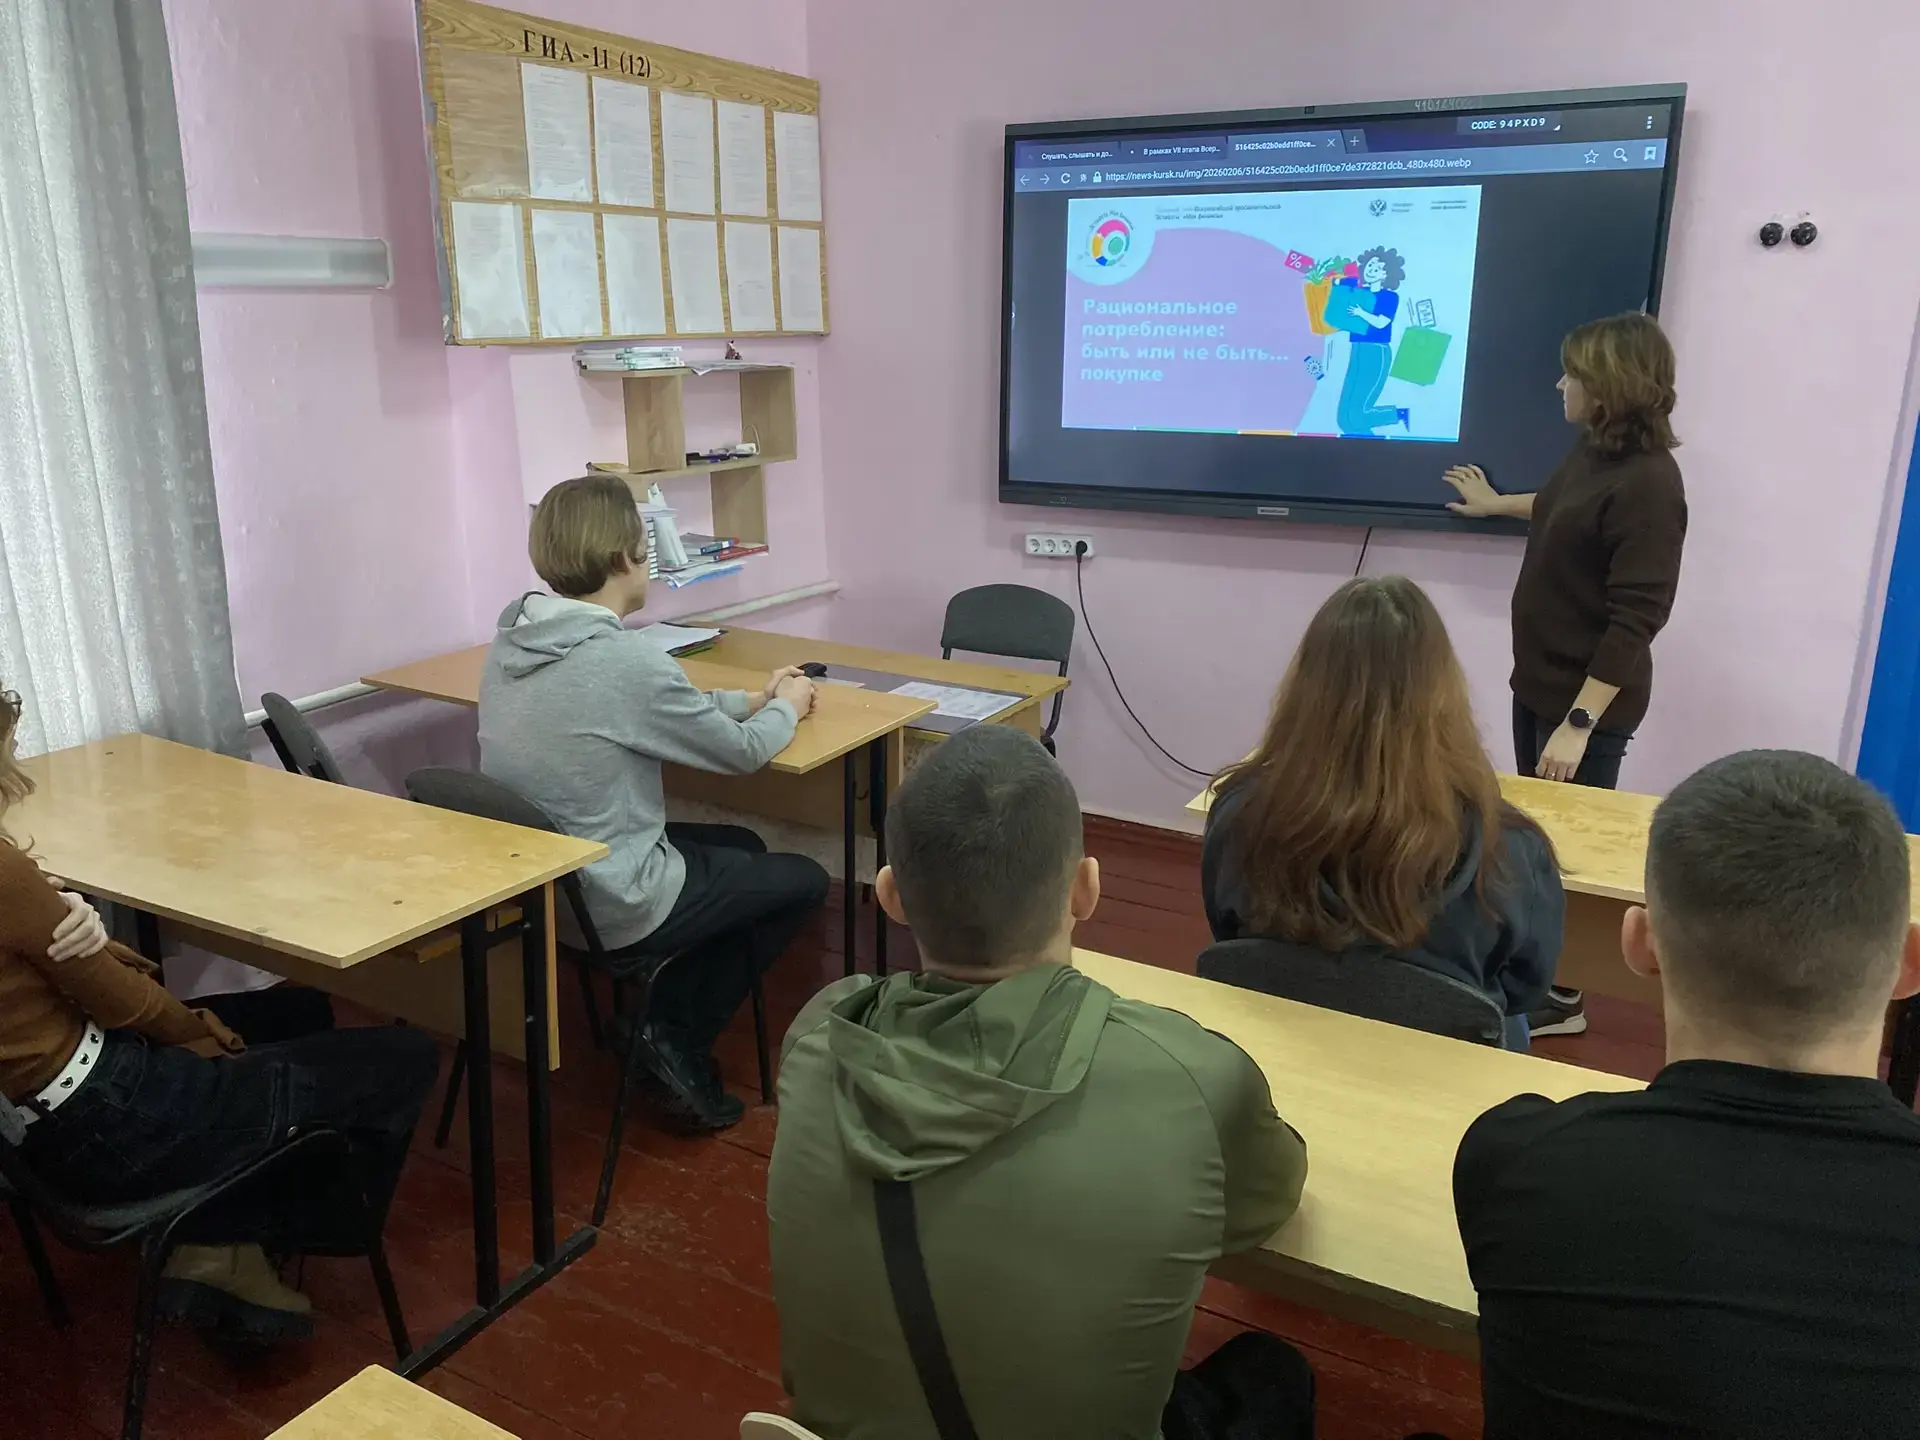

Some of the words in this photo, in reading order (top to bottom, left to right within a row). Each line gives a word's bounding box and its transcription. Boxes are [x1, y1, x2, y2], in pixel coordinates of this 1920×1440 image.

[523, 29, 575, 63] ГИА
[620, 51, 651, 79] (12)
[1471, 120, 1497, 130] CODE:
[1499, 117, 1547, 129] 94PXD9
[1143, 148, 1149, 156] В
[1082, 298, 1238, 317] Рациональное
[1081, 321, 1225, 340] потребление:
[1081, 343, 1130, 360] быть
[1137, 346, 1176, 360] или
[1183, 347, 1209, 360] не
[1215, 344, 1289, 361] быть...
[1080, 367, 1164, 384] покупке
